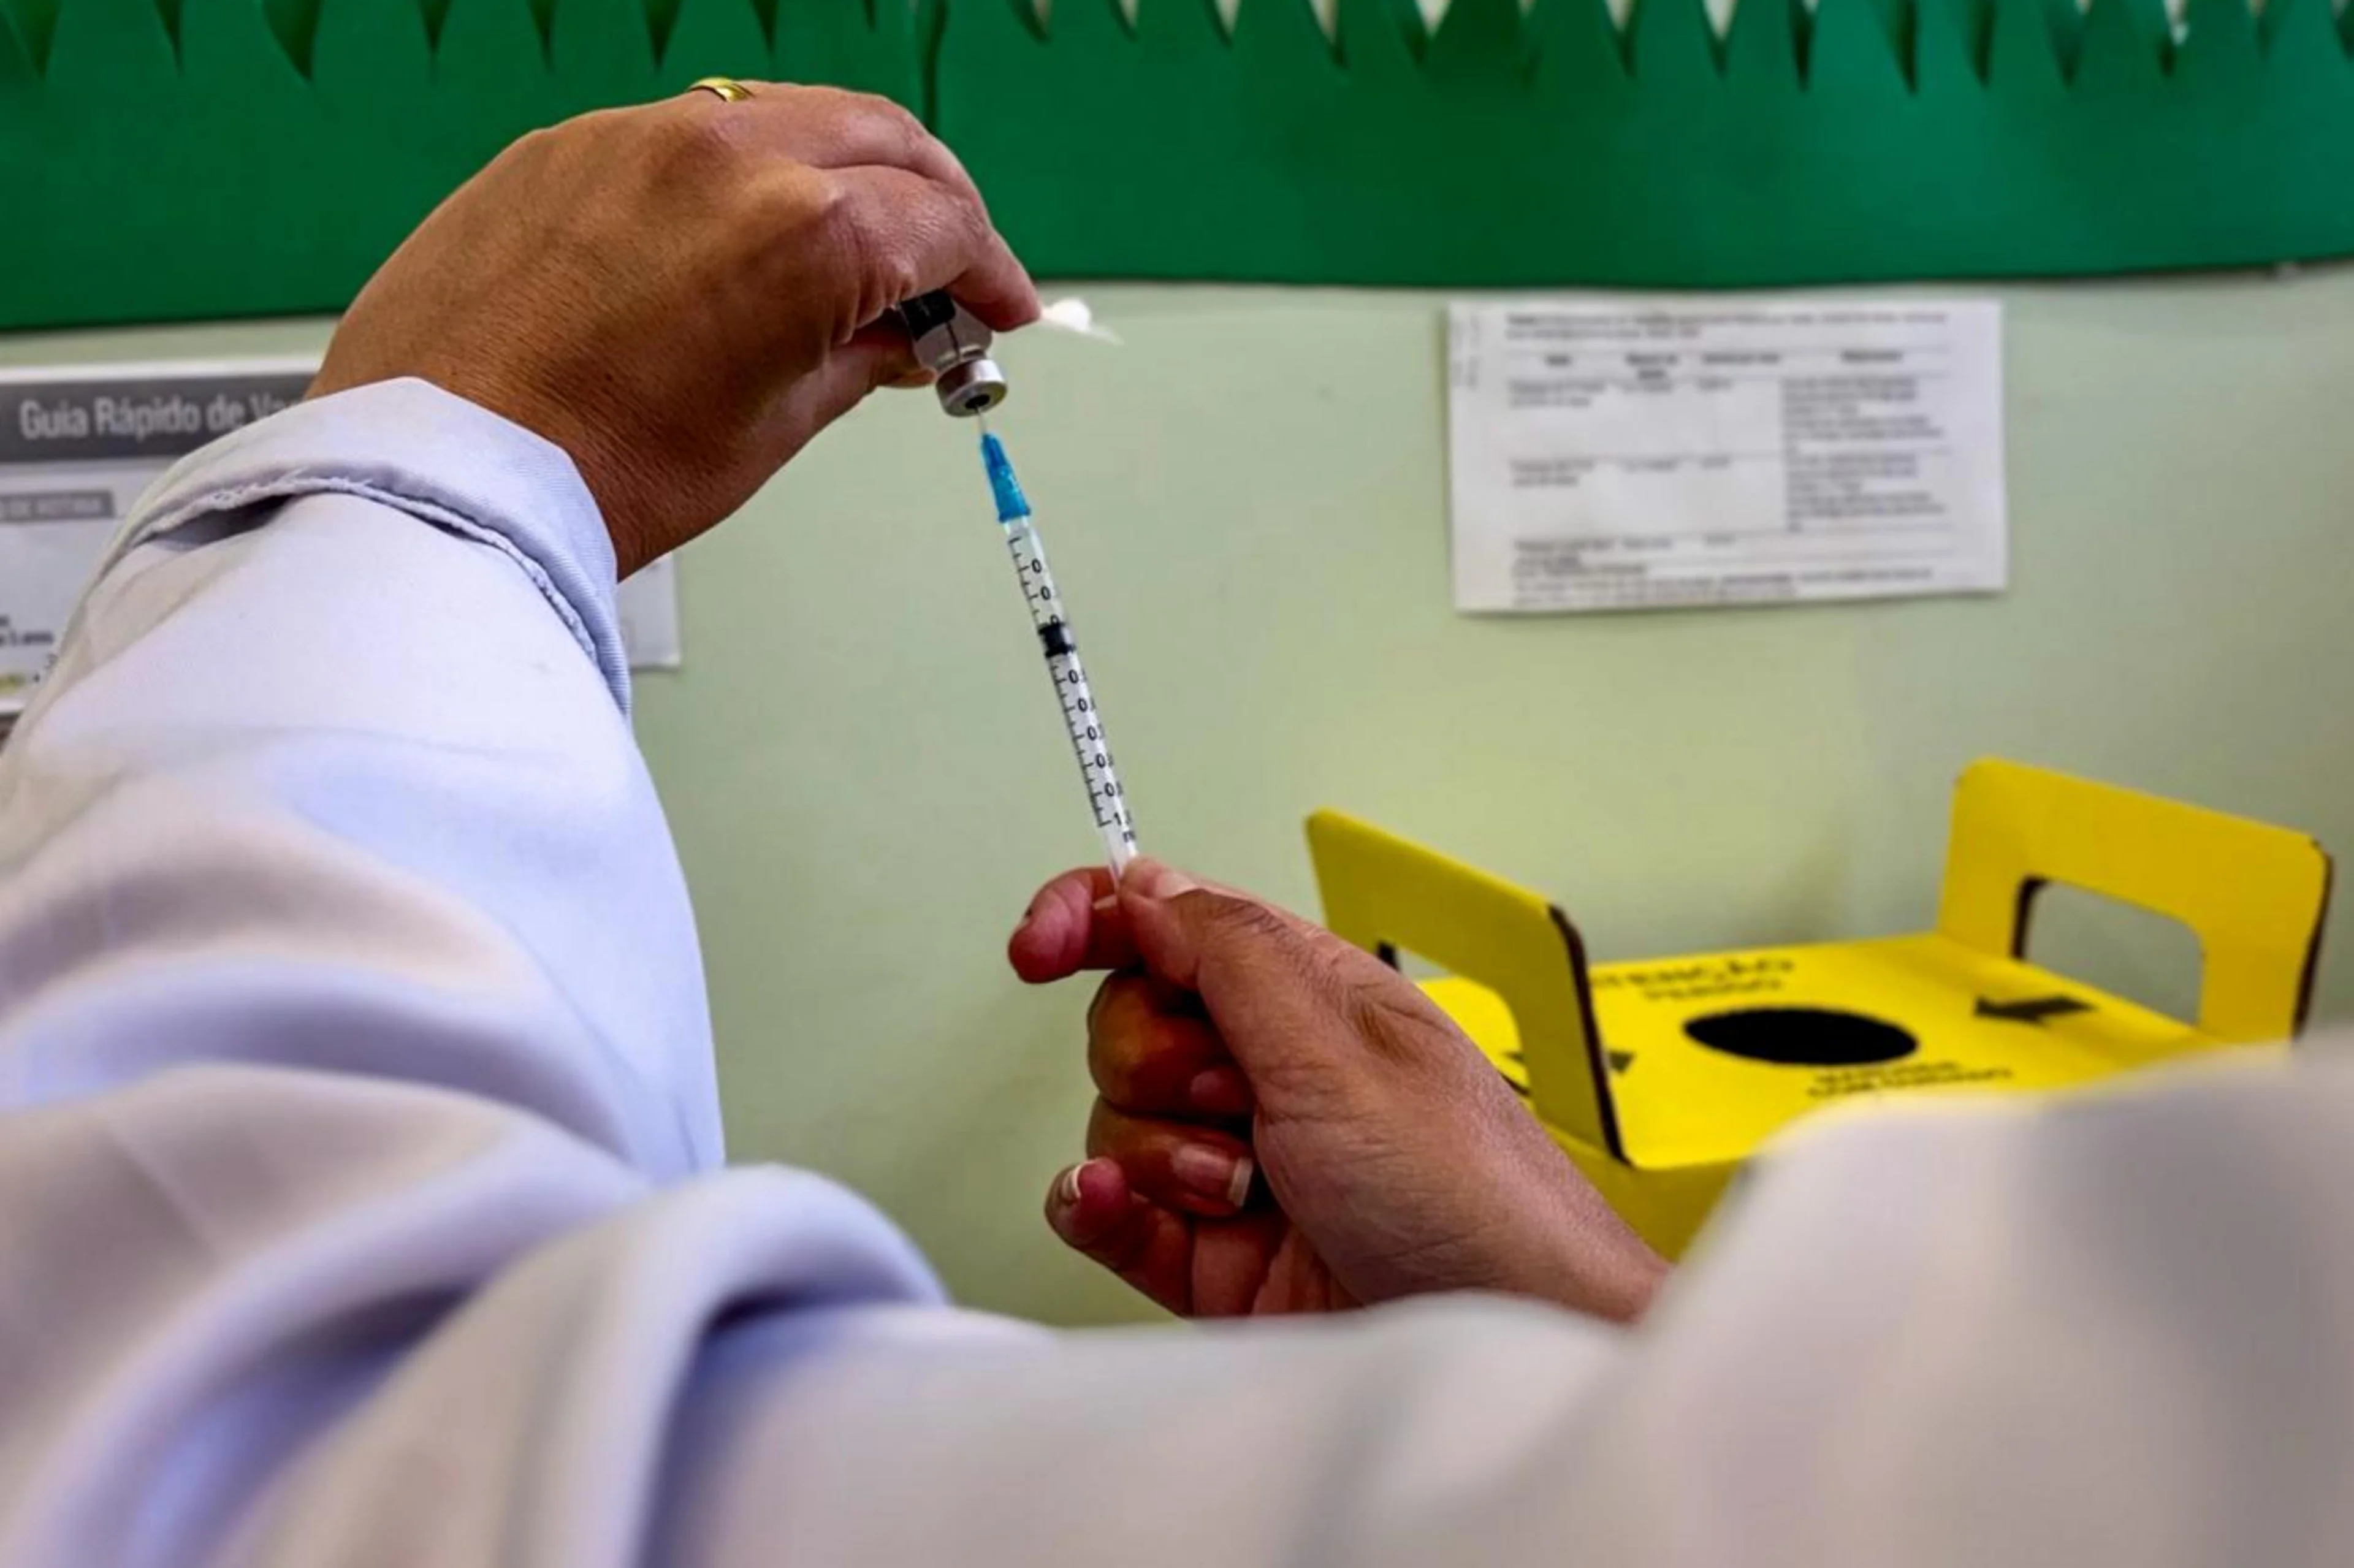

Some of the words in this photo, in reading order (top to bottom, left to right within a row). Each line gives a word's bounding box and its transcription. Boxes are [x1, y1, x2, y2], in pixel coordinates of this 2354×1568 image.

[20, 399, 88, 439] Guia
[94, 394, 200, 441] Rápido
[206, 394, 244, 428] de
